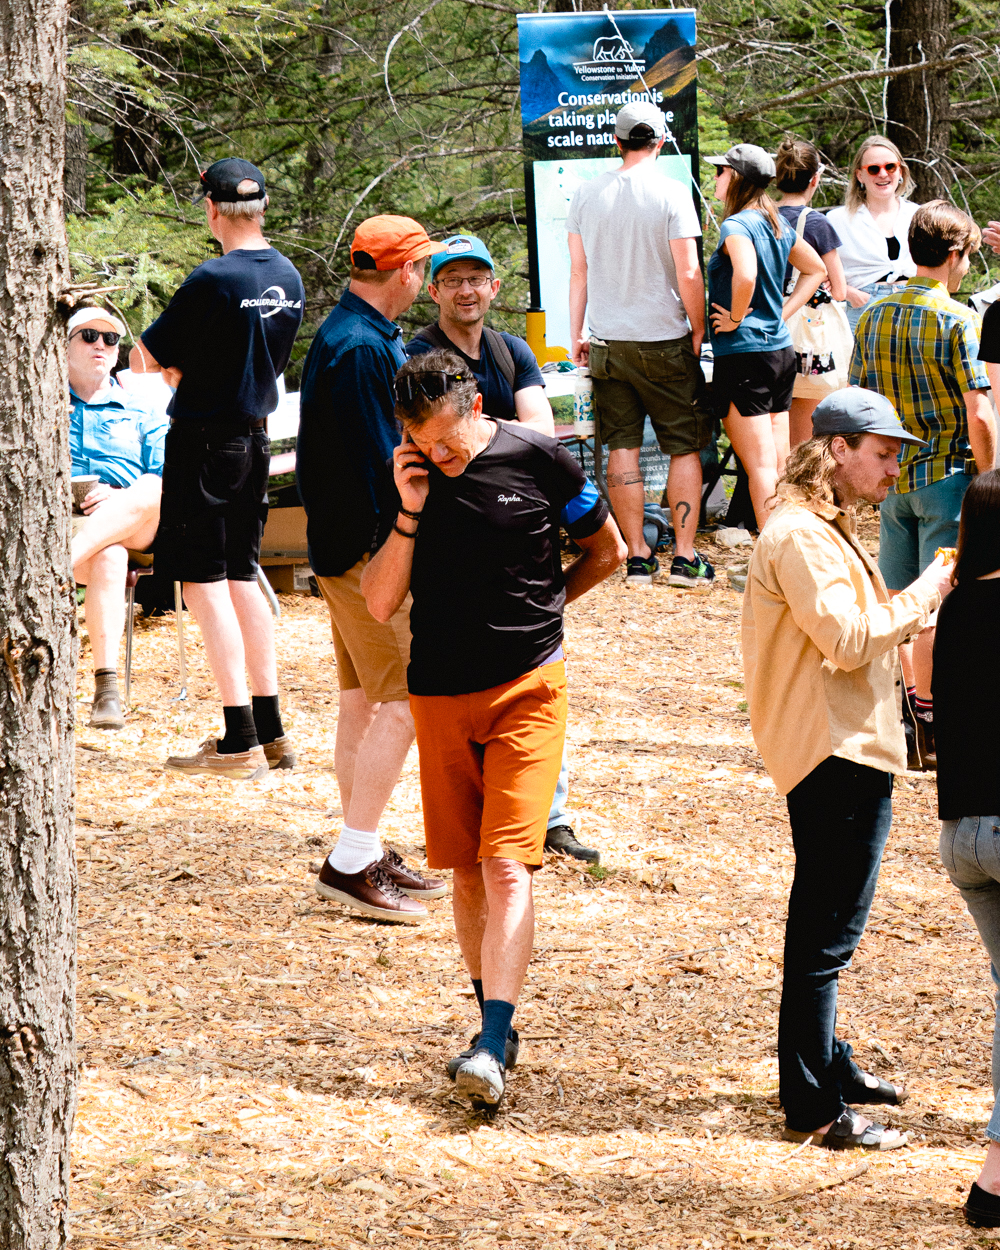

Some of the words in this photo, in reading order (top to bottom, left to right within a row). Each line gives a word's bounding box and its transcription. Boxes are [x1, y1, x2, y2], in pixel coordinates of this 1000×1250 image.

[574, 65, 615, 75] Yellowstone
[581, 74, 615, 82] Conservation
[616, 73, 639, 81] Initiative
[557, 89, 649, 107] Conservation
[652, 88, 664, 104] is
[548, 110, 595, 130] taking
[597, 108, 616, 129] pla
[547, 130, 583, 148] scale
[586, 131, 616, 146] natu
[240, 298, 295, 309] ROLLERBLADE
[640, 464, 660, 472] rotect
